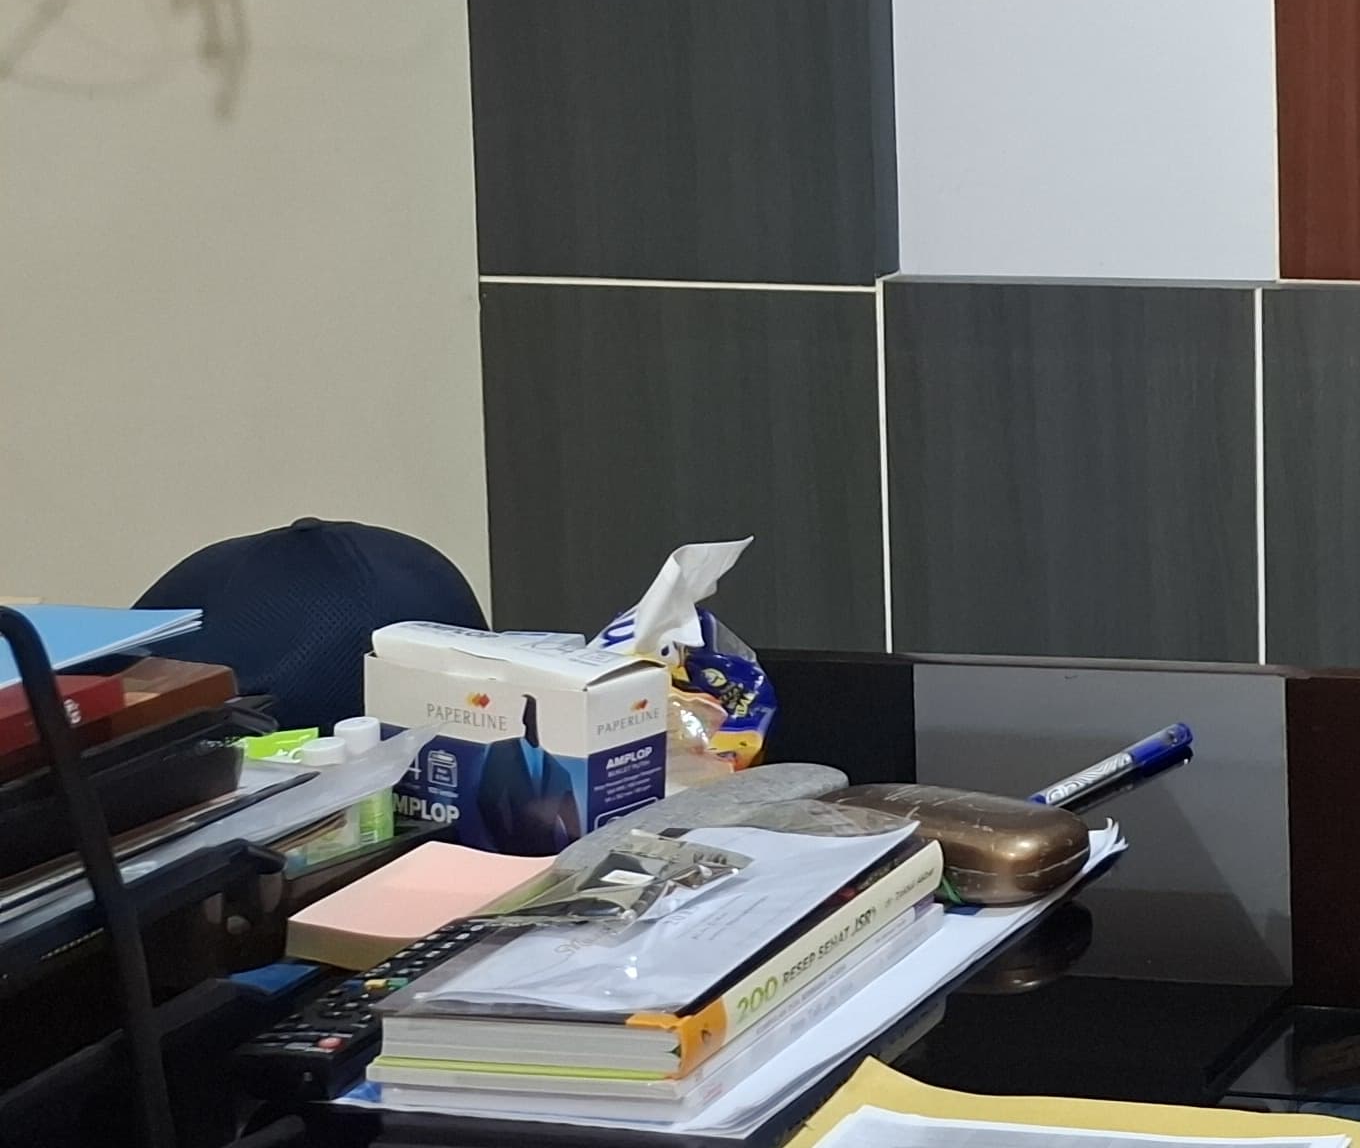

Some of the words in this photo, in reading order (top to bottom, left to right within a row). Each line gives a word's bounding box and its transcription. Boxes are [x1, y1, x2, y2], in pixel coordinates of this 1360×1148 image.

[426, 703, 509, 732] PAPERLINE
[596, 707, 661, 735] PAPERLINE
[605, 746, 653, 771] AMPLOP
[392, 792, 460, 824] MPLOP
[735, 974, 779, 1026] 200
[782, 951, 817, 987] RESEP
[817, 926, 851, 960] SEHAT
